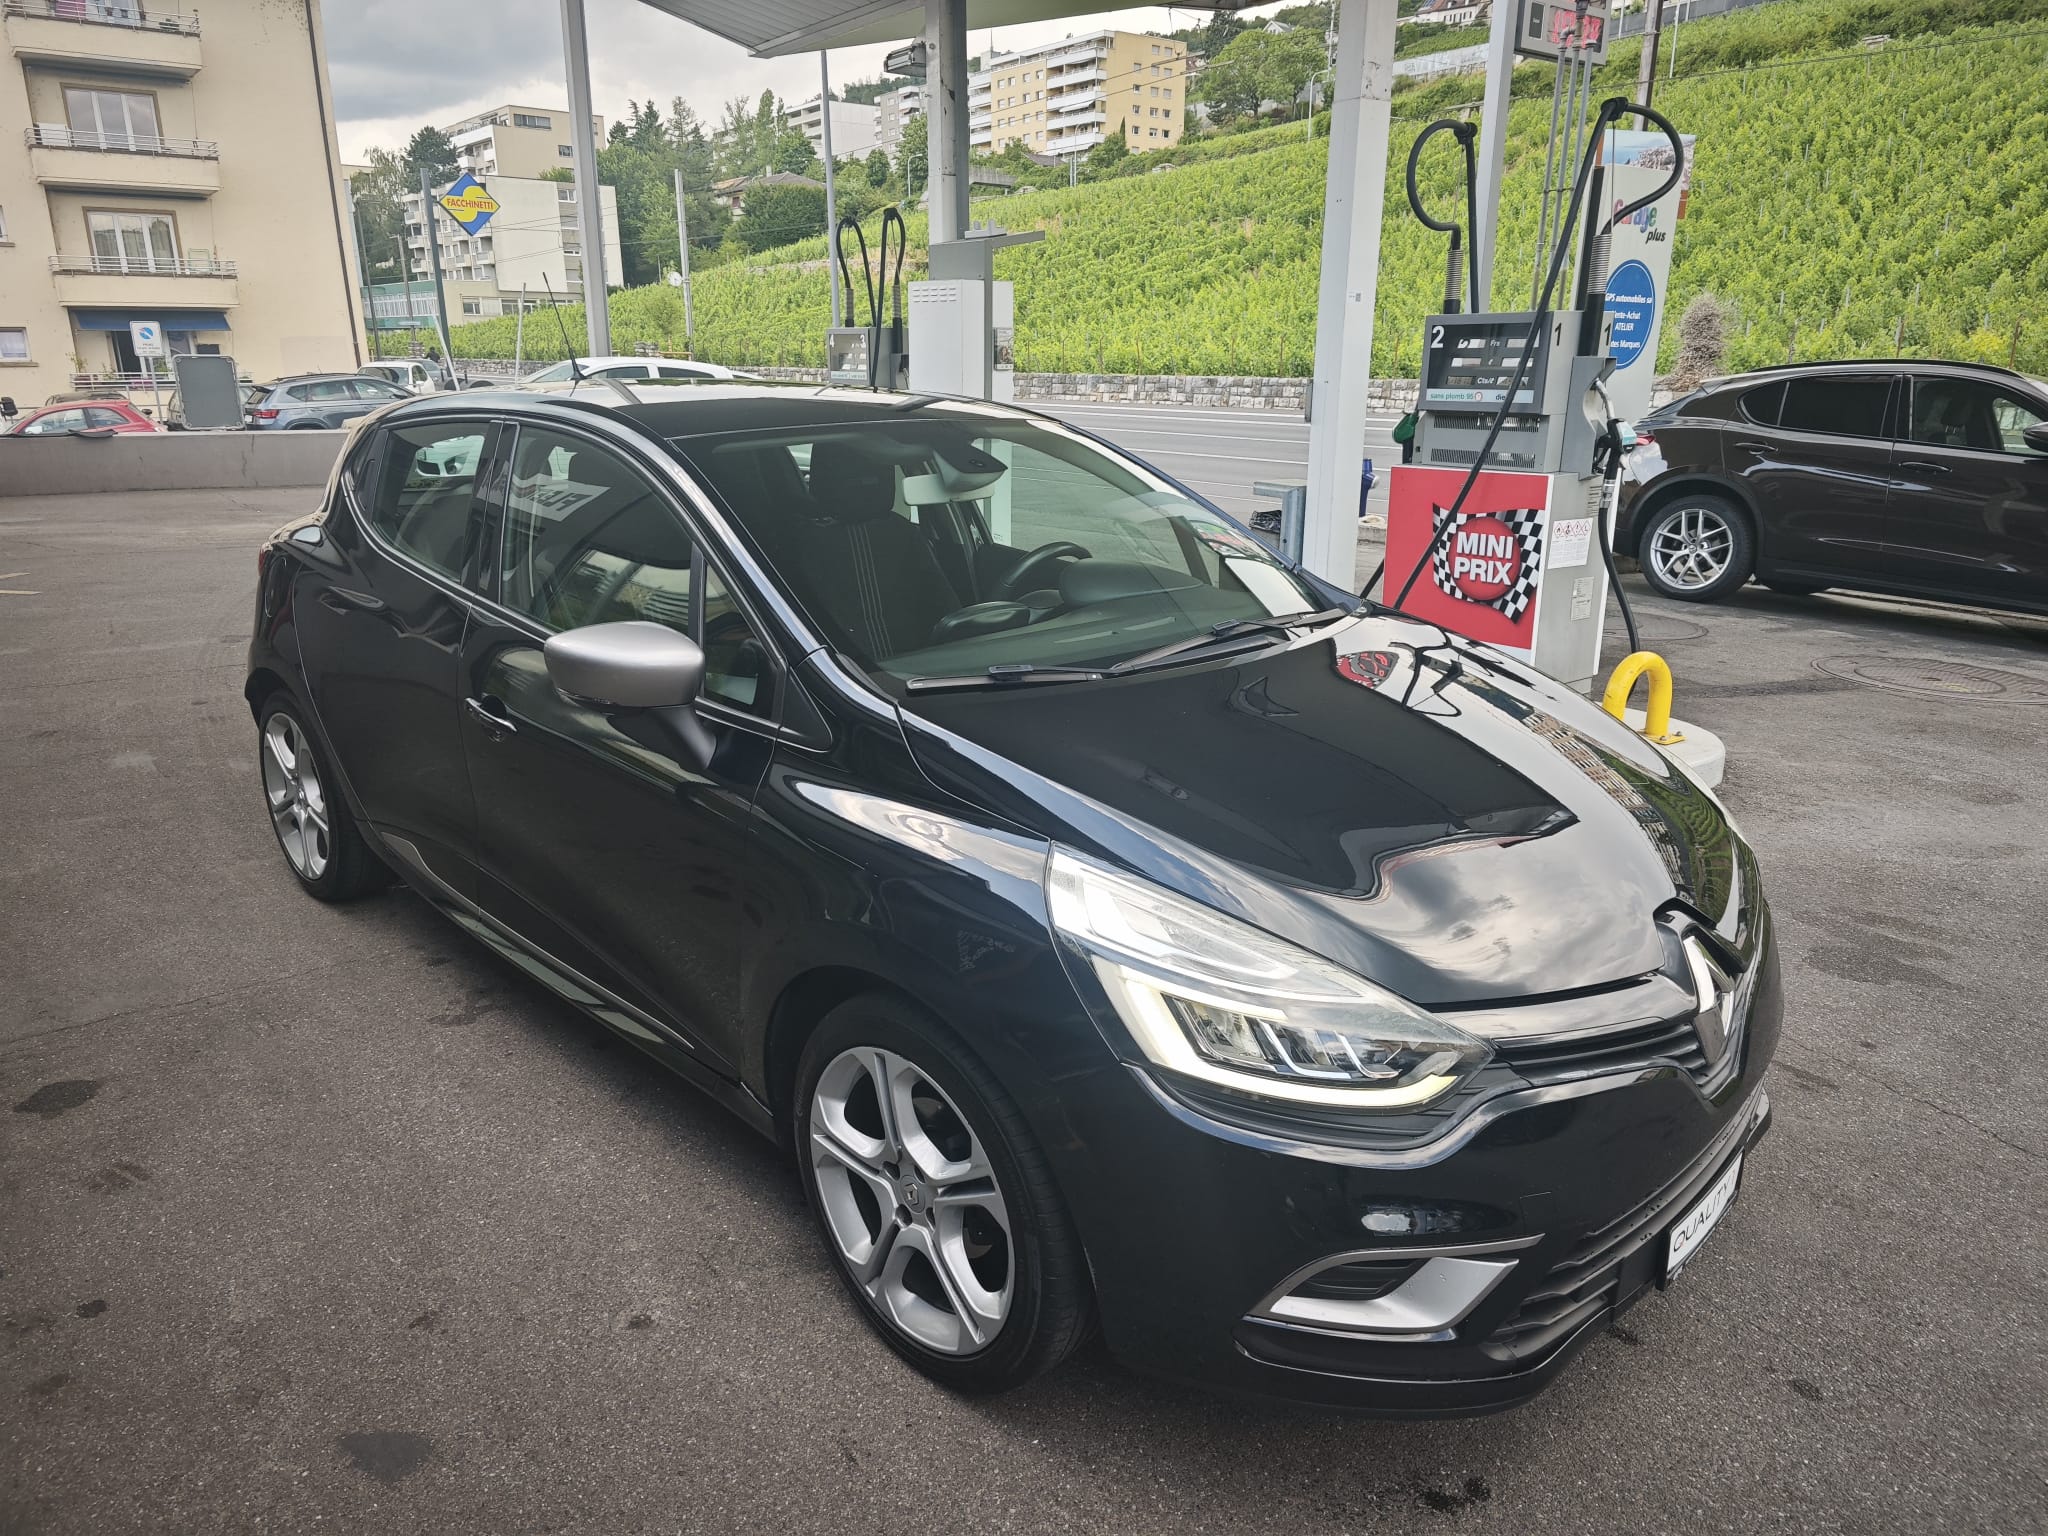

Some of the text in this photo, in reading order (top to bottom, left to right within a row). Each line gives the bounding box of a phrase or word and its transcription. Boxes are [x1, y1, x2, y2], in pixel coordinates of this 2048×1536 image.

[446, 198, 494, 210] FACCHINETTI
[1612, 199, 1658, 233] Gaage
[1645, 228, 1667, 244] plus
[1614, 311, 1641, 320] ente-Achat
[1430, 325, 1445, 349] 2
[1554, 322, 1562, 346] 1
[1604, 322, 1612, 346] 1
[1445, 392, 1465, 400] plomb
[1456, 531, 1514, 560] MINI
[1453, 556, 1513, 586] PRIX
